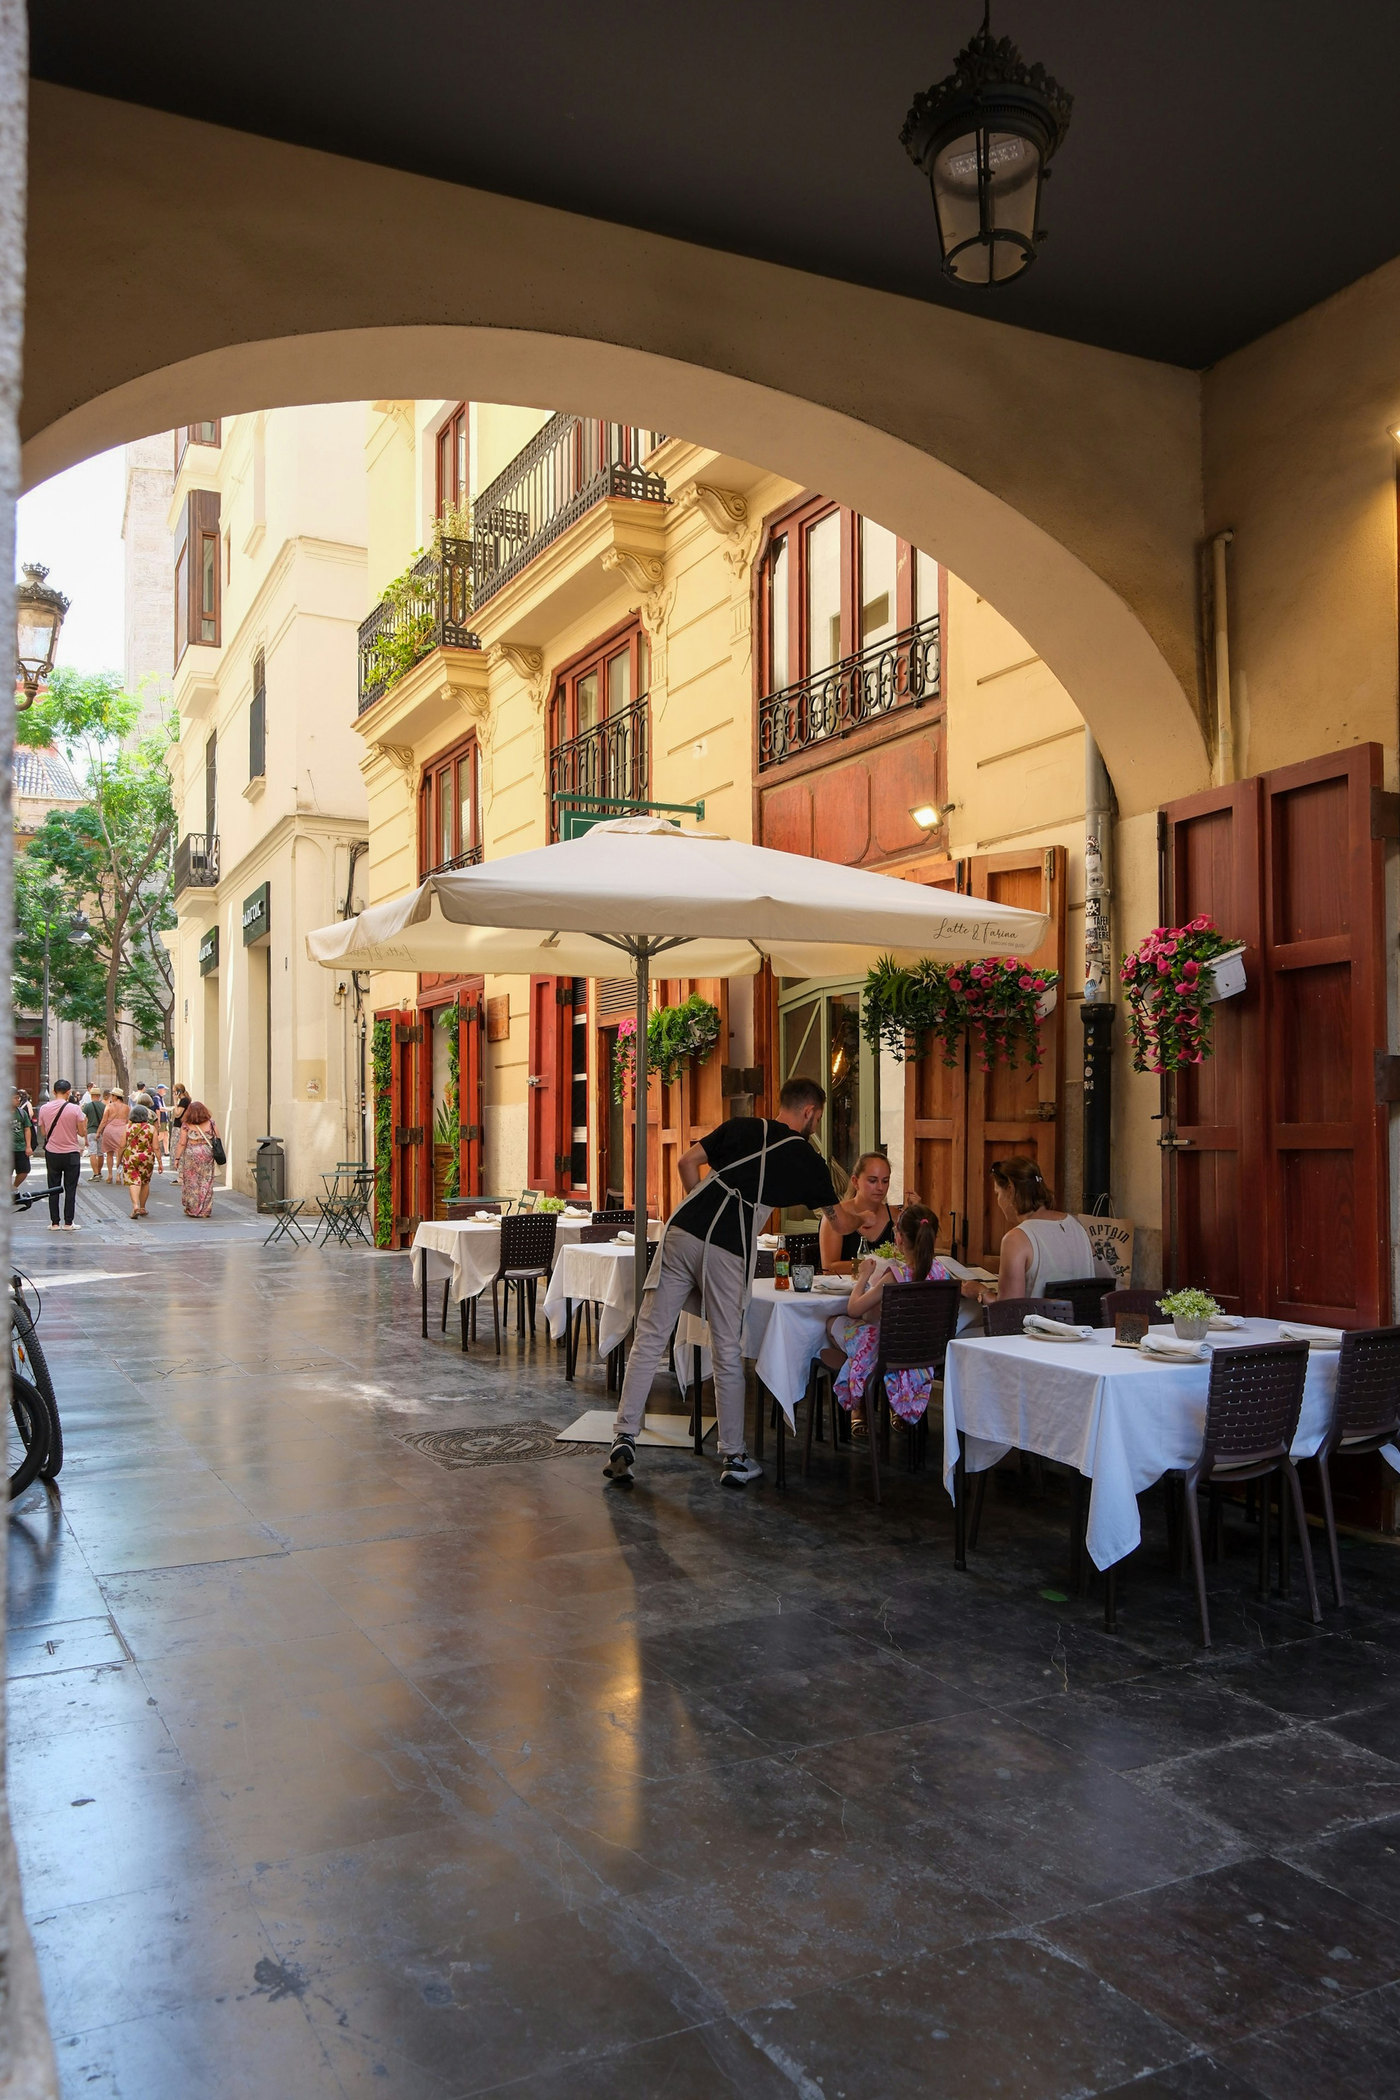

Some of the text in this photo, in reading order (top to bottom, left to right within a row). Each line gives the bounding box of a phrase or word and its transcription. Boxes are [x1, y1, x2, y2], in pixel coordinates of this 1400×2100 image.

[933, 917, 1019, 944] Latte & Farina
[1088, 1224, 1130, 1243] APTAIN
